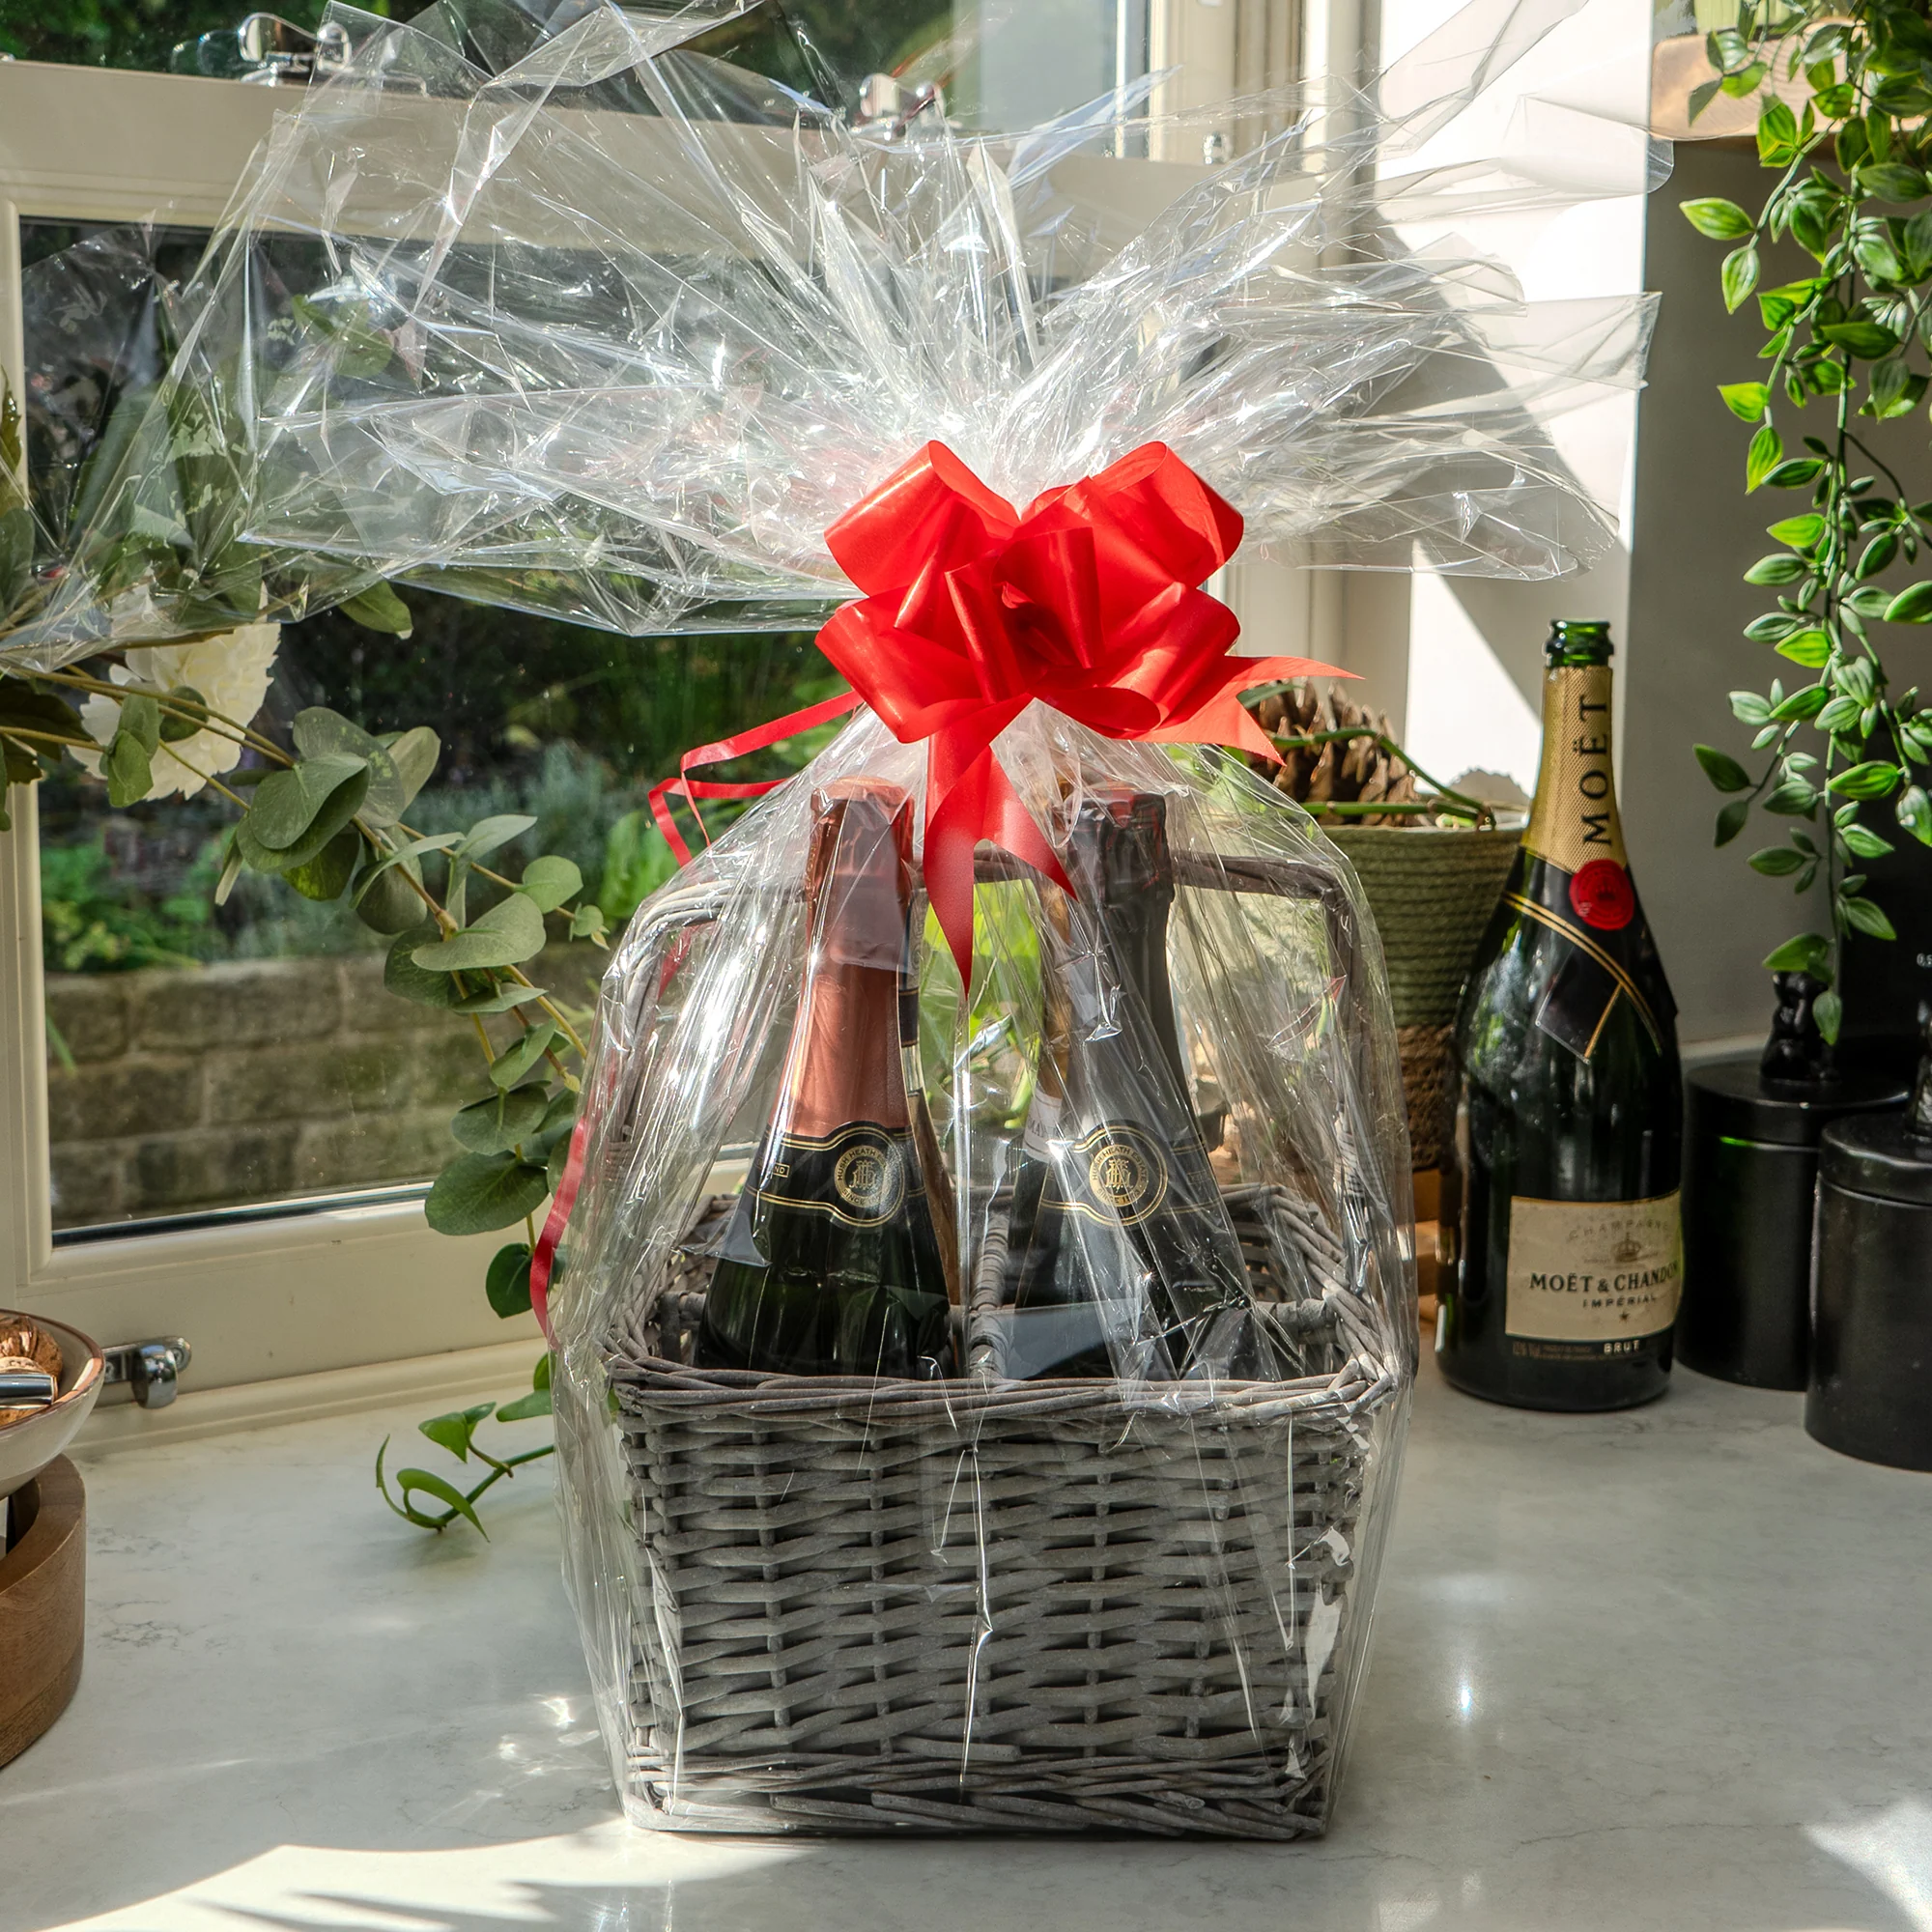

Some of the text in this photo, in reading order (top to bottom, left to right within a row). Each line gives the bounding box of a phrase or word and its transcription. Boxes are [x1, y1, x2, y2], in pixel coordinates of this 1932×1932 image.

[1573, 695, 1612, 846] MOËT
[838, 1157, 850, 1181] HUSH
[849, 1148, 876, 1159] HEATH
[1102, 1146, 1130, 1157] HEATH
[1131, 1151, 1148, 1181] ESTATE
[1529, 1272, 1593, 1293] MOËT
[1597, 1278, 1609, 1293] &
[1604, 1340, 1640, 1354] BRUT
